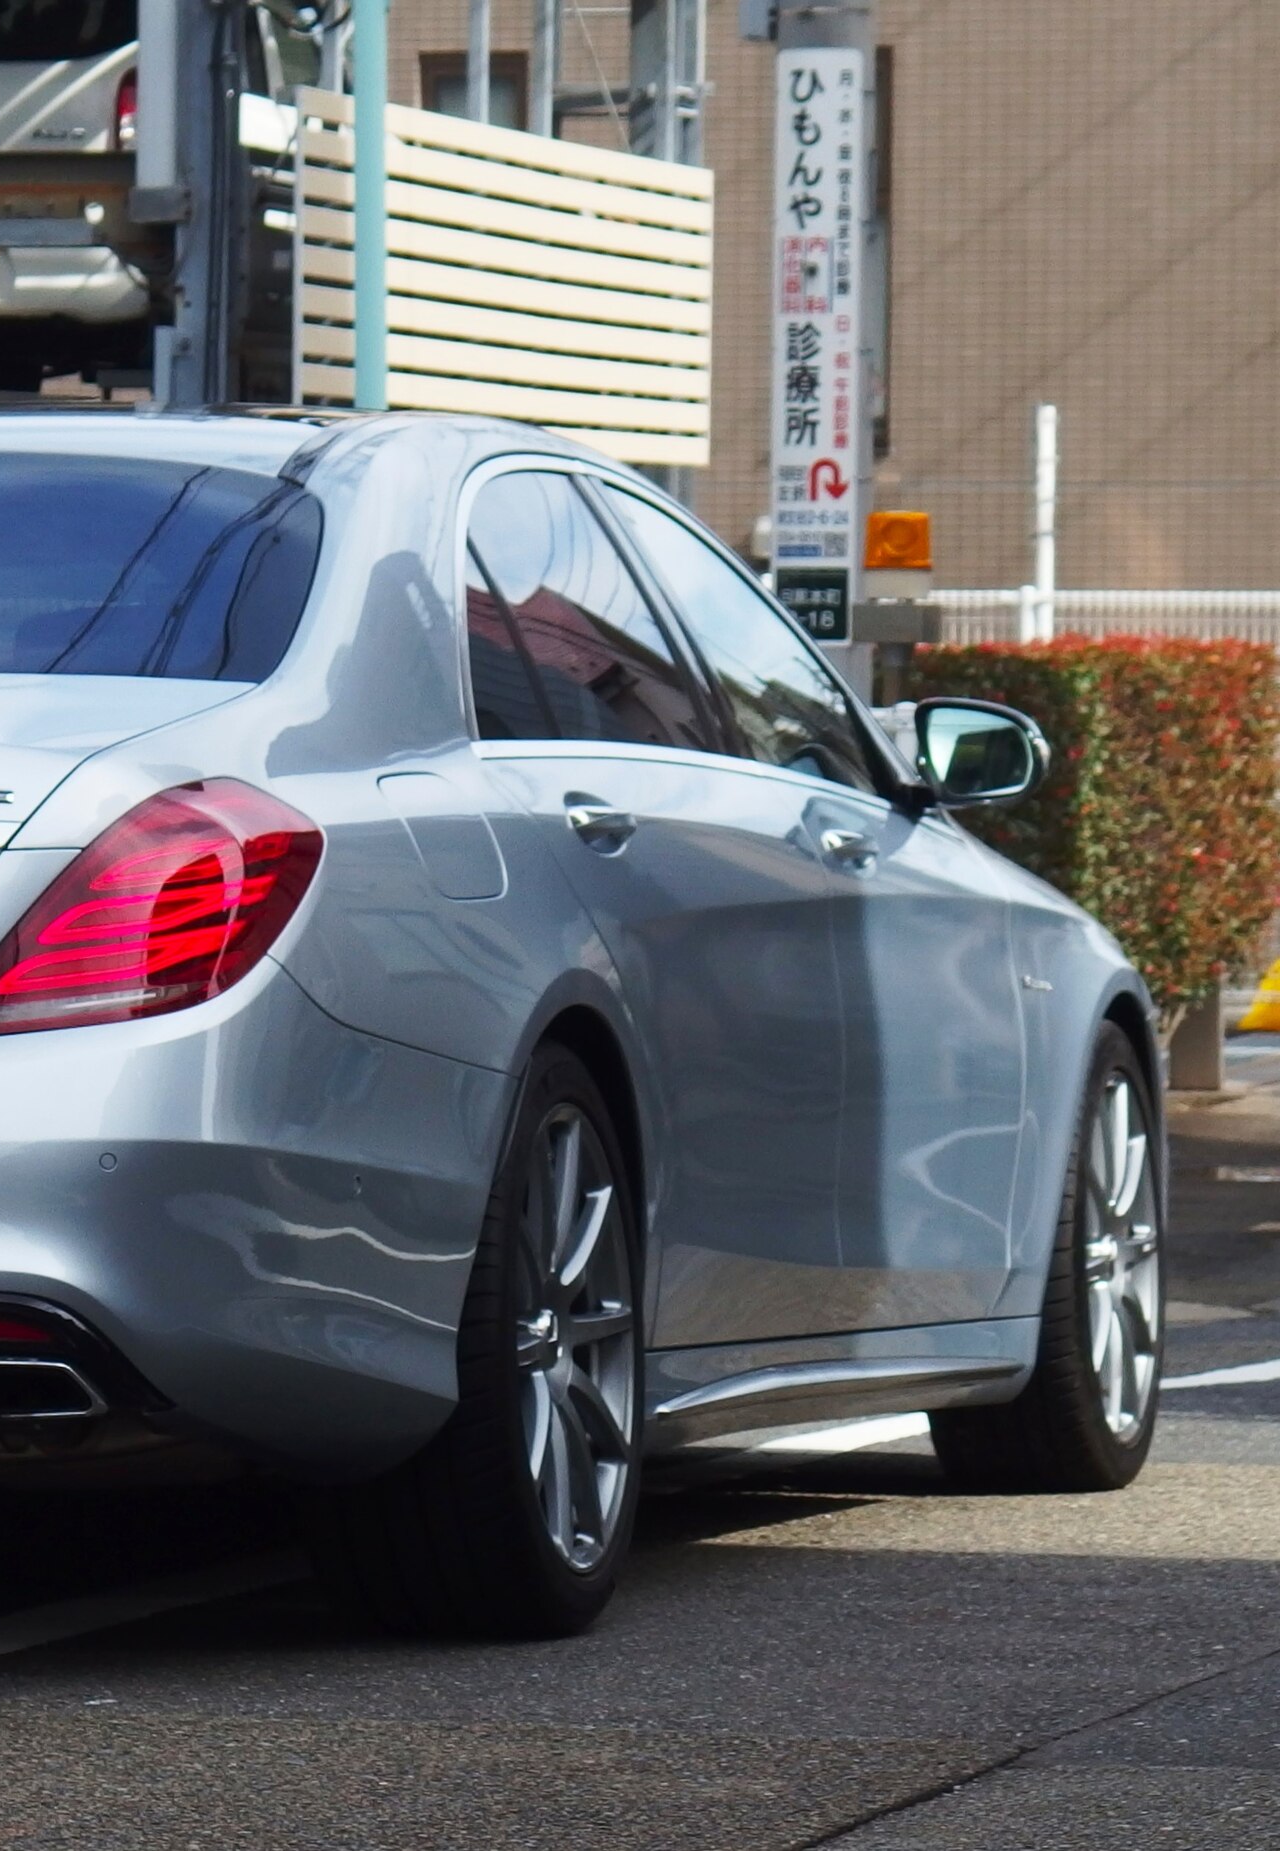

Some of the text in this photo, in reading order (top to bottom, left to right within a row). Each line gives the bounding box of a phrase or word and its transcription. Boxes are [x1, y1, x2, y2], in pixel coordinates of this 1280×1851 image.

[787, 67, 825, 230] ひもんや
[785, 321, 821, 446] 診療所
